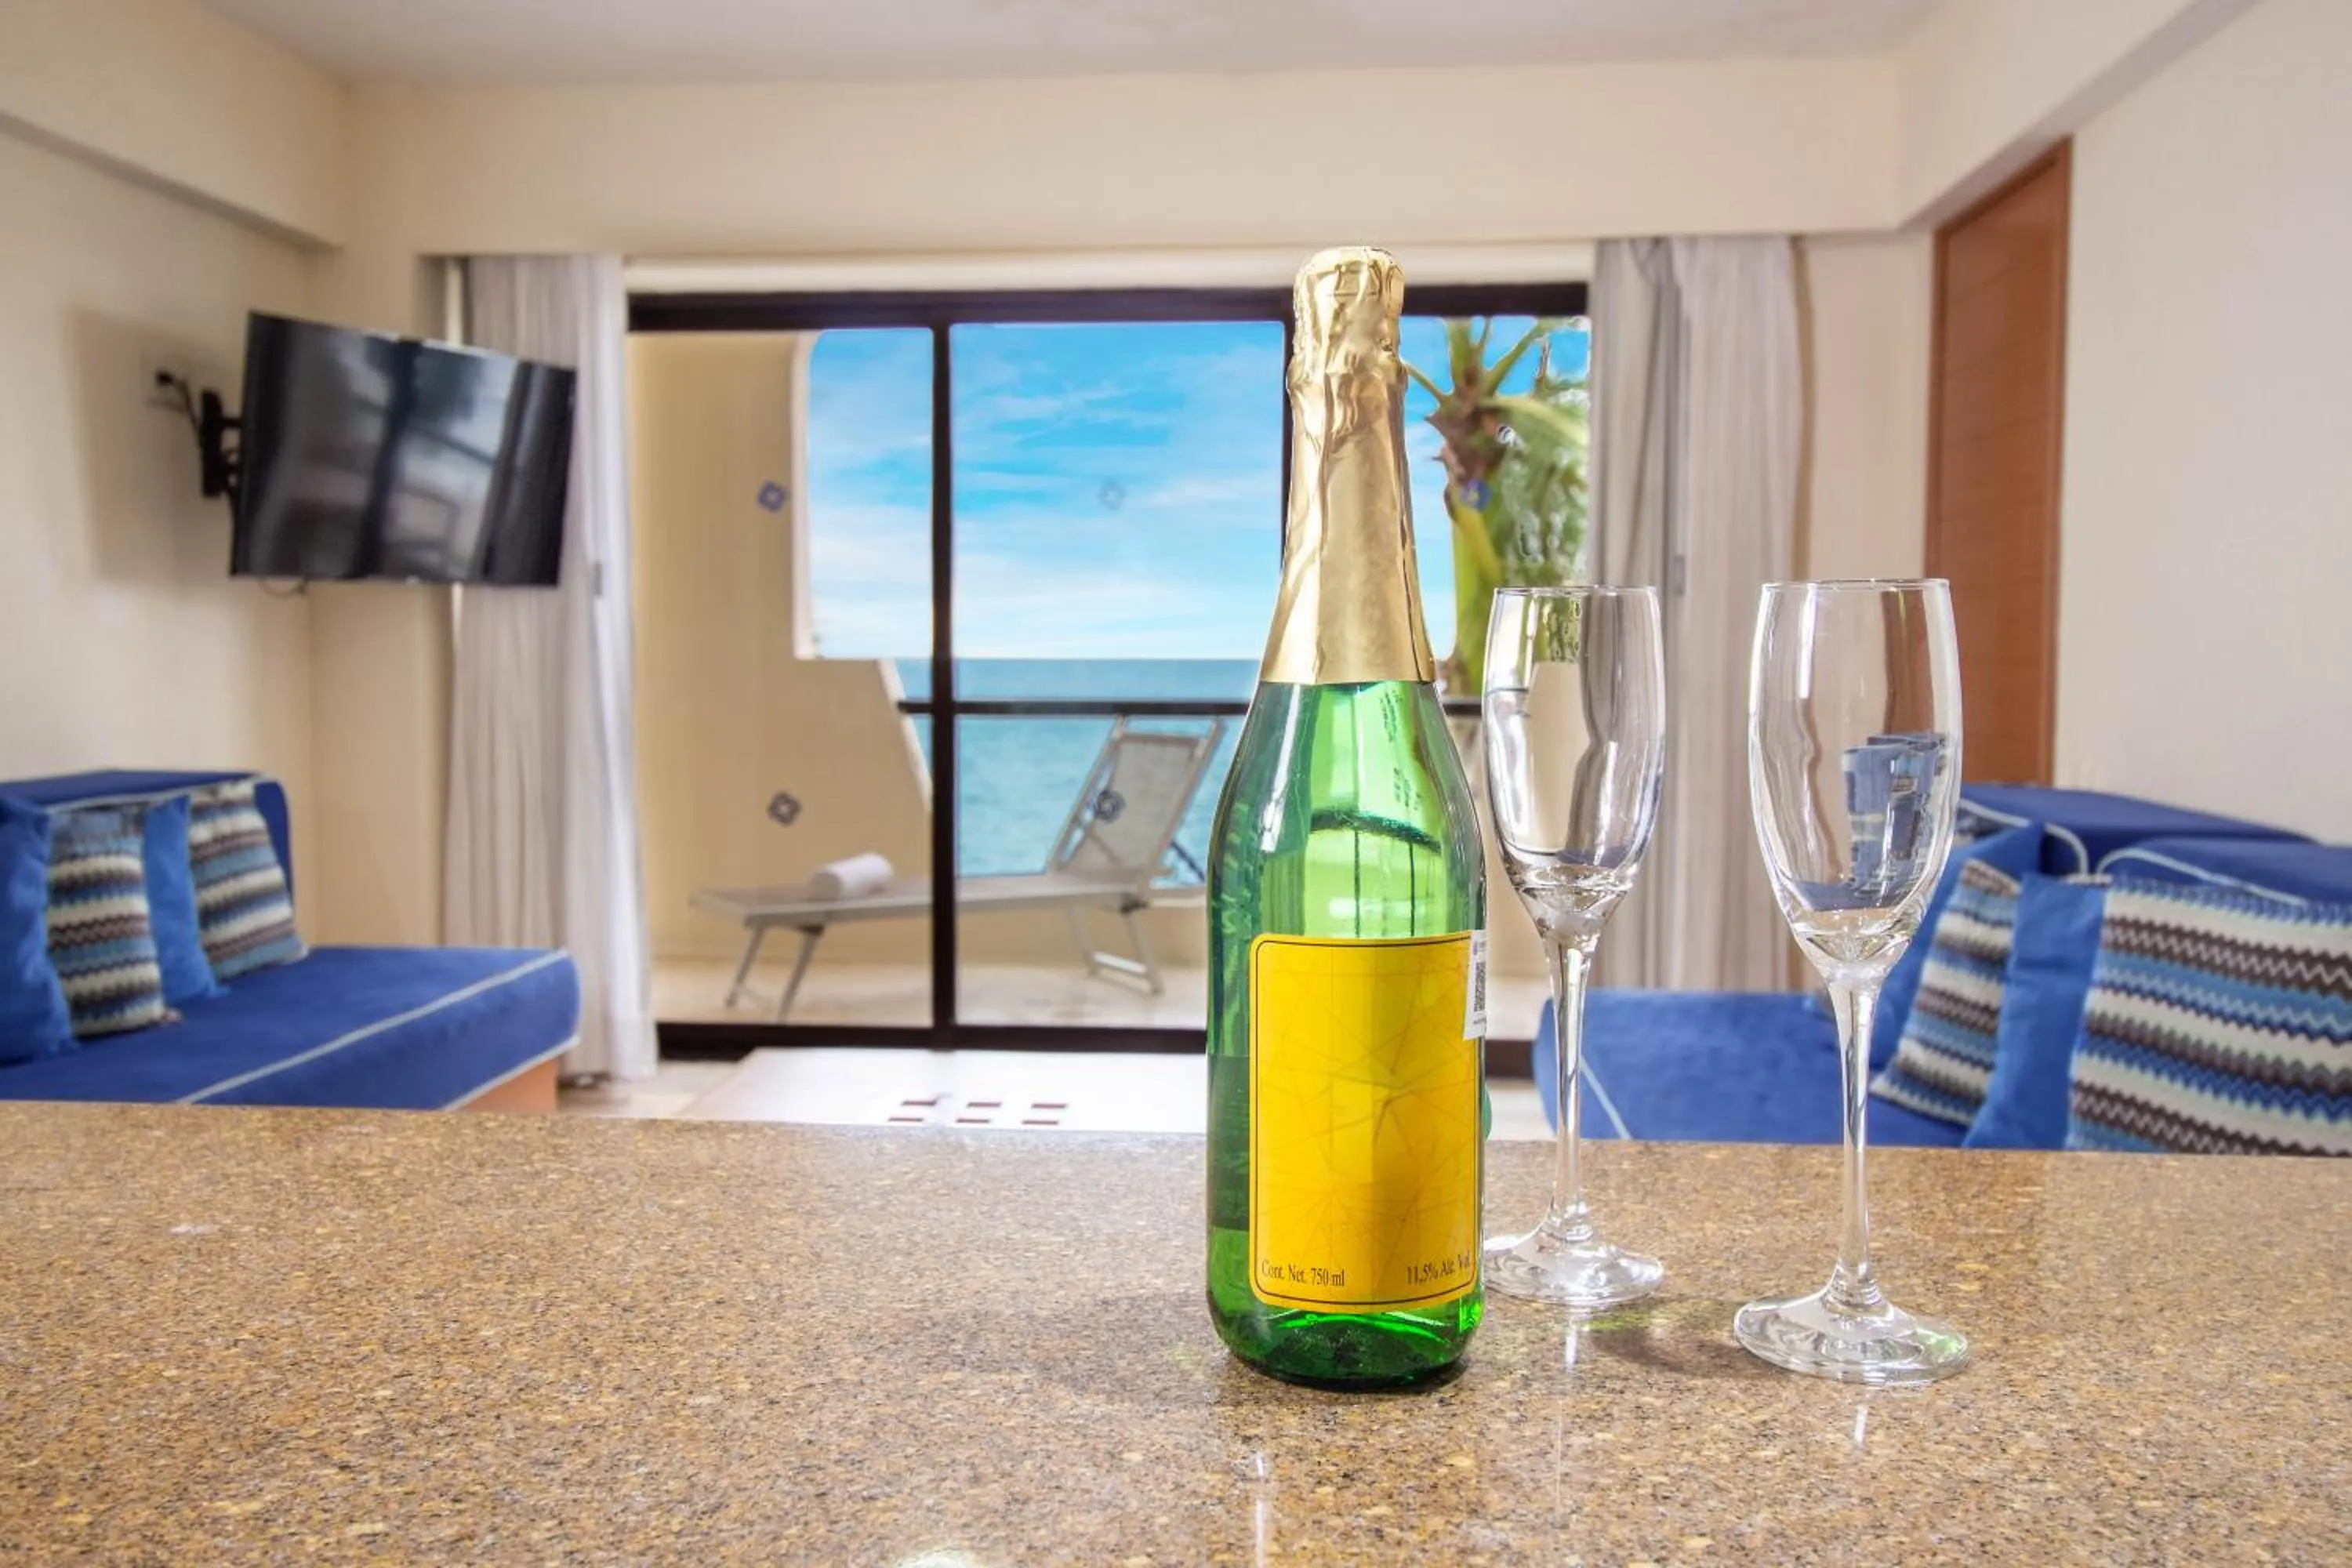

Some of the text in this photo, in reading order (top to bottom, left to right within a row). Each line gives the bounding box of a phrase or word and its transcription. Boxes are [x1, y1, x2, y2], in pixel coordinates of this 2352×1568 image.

[1261, 1258, 1345, 1287] Cont. Net. 750 ml
